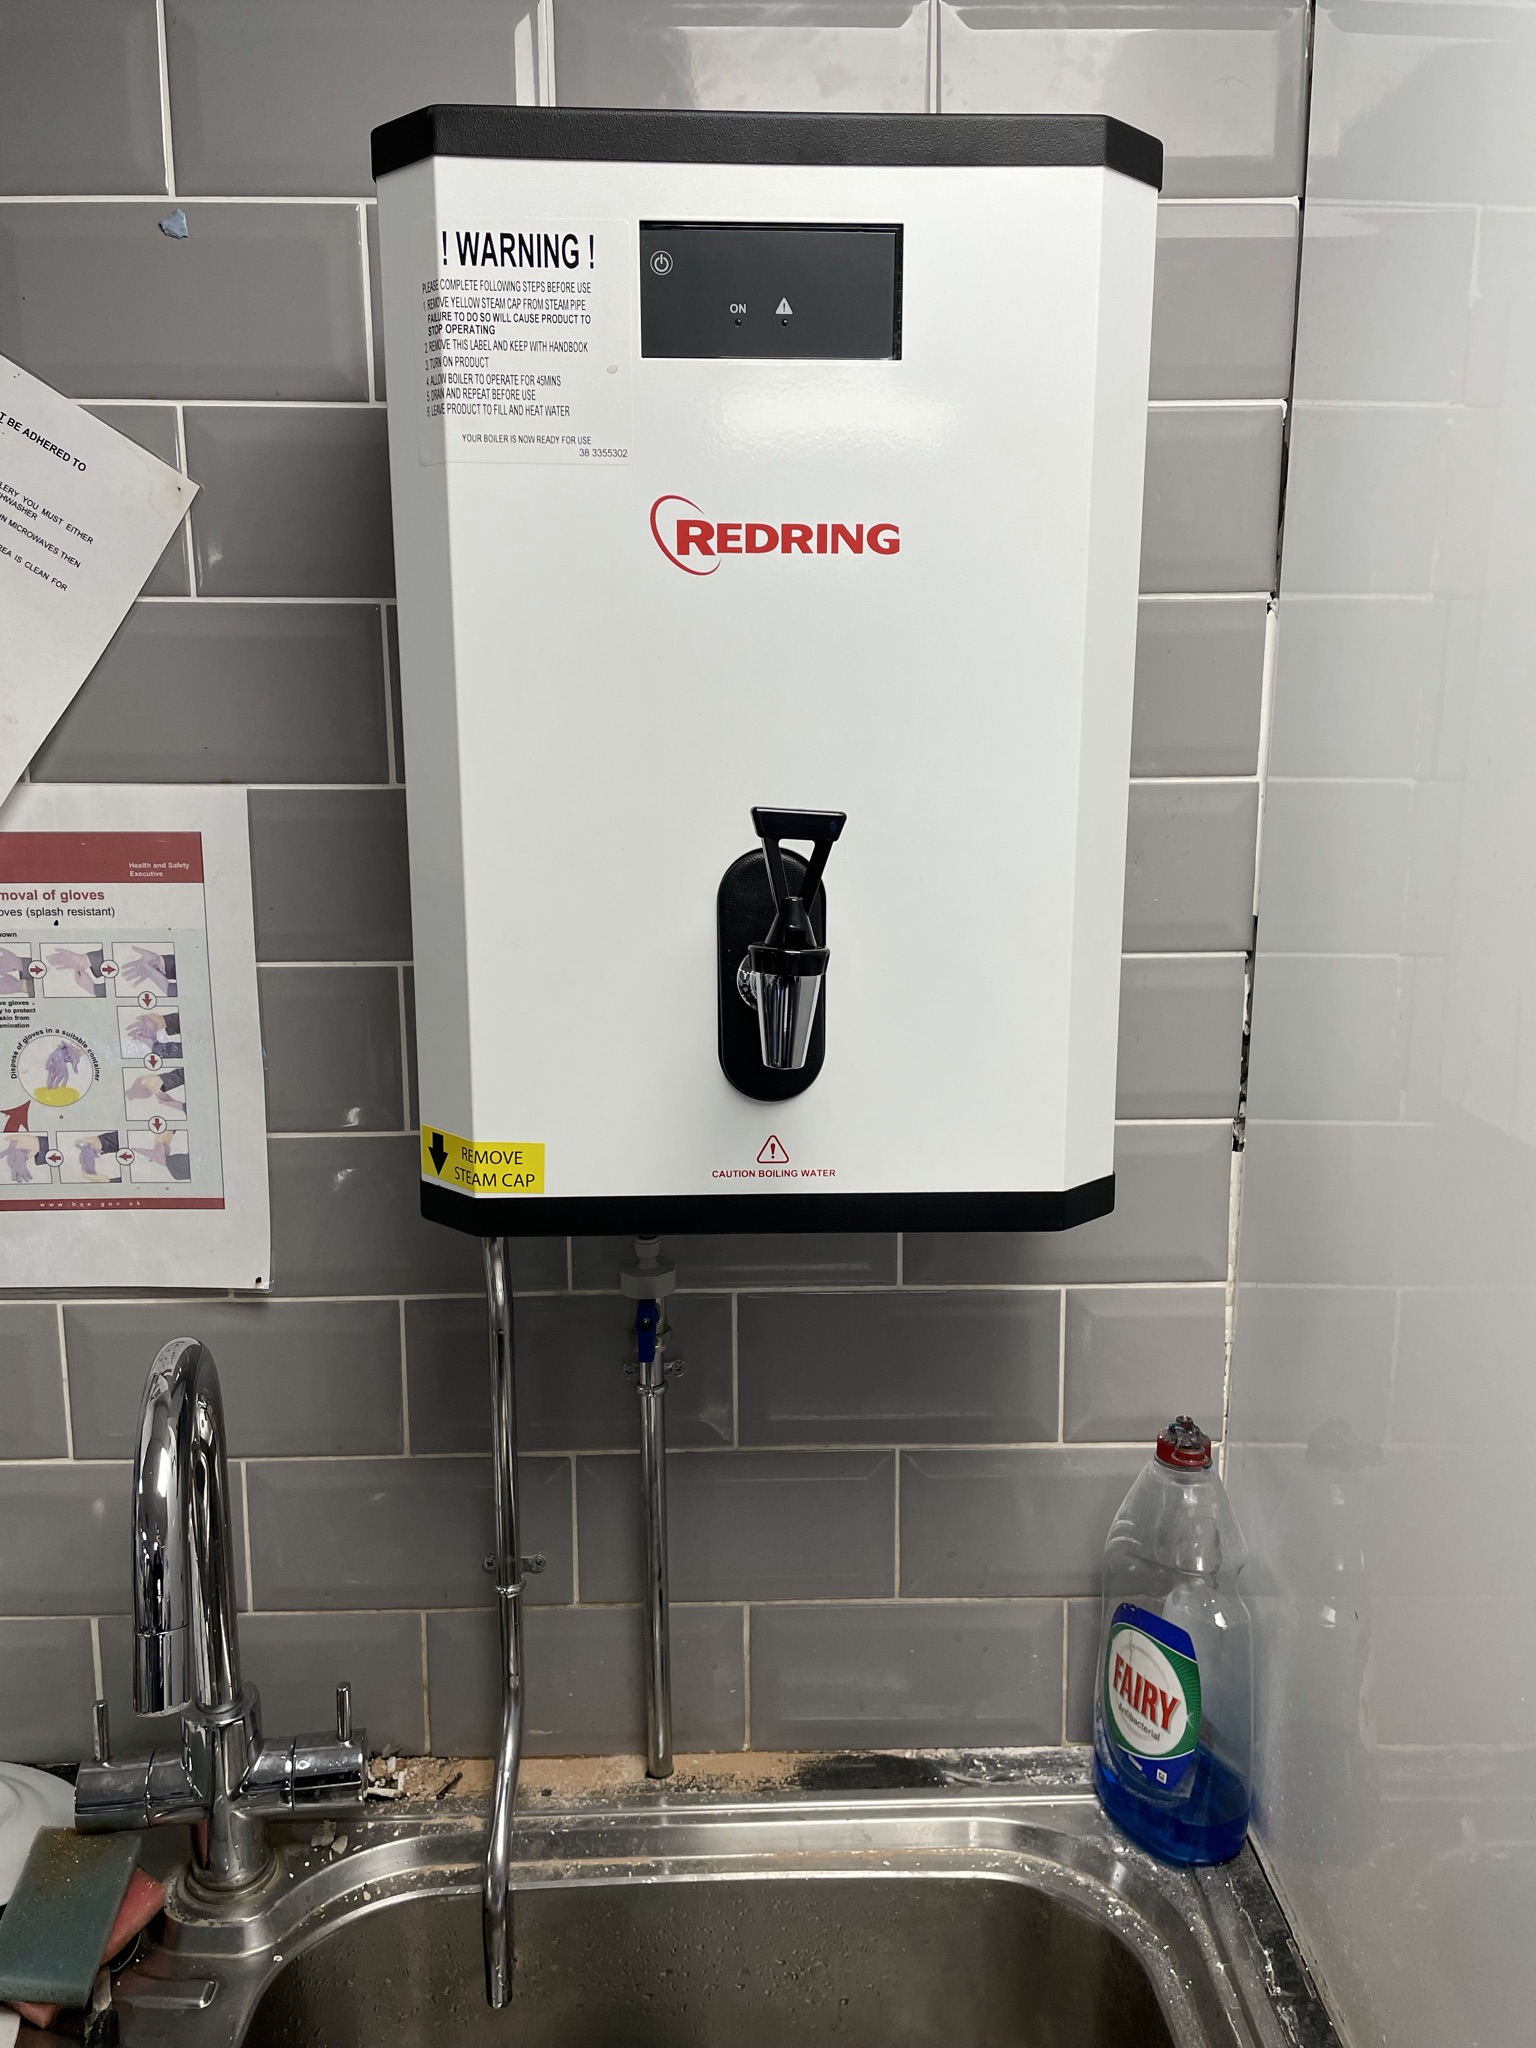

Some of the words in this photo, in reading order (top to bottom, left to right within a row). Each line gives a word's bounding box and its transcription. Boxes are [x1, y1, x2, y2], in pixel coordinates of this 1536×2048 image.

[456, 231, 580, 270] WARNING
[422, 279, 438, 294] PLEASE
[440, 279, 478, 291] COMPLETE
[480, 280, 521, 292] FOLLOWING
[522, 281, 545, 293] STEPS
[547, 281, 575, 293] BEFORE
[577, 282, 591, 294] USE
[427, 297, 449, 310] REMOVE
[451, 297, 480, 308] YELLOW
[481, 297, 506, 309] STEAM
[507, 298, 521, 309] CAP
[523, 299, 543, 310] FROM
[545, 299, 569, 310] STEAM
[570, 300, 586, 311] PIPE
[730, 303, 747, 314] ON
[428, 312, 452, 324] FAILURE
[454, 312, 465, 322] TO
[467, 312, 478, 322] DO
[480, 312, 491, 322] SO
[493, 313, 511, 322] WILL
[513, 313, 539, 323] CAUSE
[541, 314, 578, 324] PRODUCT
[580, 315, 591, 324] TO
[428, 324, 442, 336] STOP
[445, 324, 496, 335] OPERATING
[429, 339, 450, 352] REMOVE
[452, 339, 469, 350] THIS
[470, 340, 492, 351] LABEL
[493, 340, 508, 351] AND
[510, 341, 528, 352] KEEP
[530, 341, 547, 352] WITH
[549, 341, 588, 353] HANDBOOK
[430, 356, 442, 369] TURN
[443, 356, 453, 367] ON
[455, 357, 489, 368] PRODUCT
[430, 374, 446, 386] ALLOW
[448, 373, 474, 384] BOILER
[475, 374, 484, 385] TO
[486, 374, 519, 385] OPERATE
[520, 375, 535, 386] FOR
[537, 375, 561, 386] 45MINS
[446, 388, 461, 399] AND
[463, 388, 490, 399] REPEAT
[492, 389, 520, 400] BEFORE
[522, 390, 536, 400] USE
[431, 403, 445, 417] LEAVE
[446, 403, 481, 415] PRODUCT
[483, 404, 492, 415] TO
[494, 404, 507, 415] FILL
[509, 405, 524, 415] AND
[526, 405, 544, 416] HEAT
[545, 405, 570, 417] WATER
[7, 417, 22, 432] BE
[22, 428, 71, 462] ADHERED
[73, 458, 87, 472] TO
[462, 434, 482, 442] YOUR
[484, 435, 508, 443] BOILER
[510, 435, 517, 443] IS
[519, 435, 535, 443] NOW
[536, 436, 560, 444] READY
[561, 436, 576, 444] FOR
[578, 436, 591, 444] USE
[579, 449, 589, 457] 38
[592, 449, 628, 458] 3355302
[0, 492, 38, 520] HWASHER
[0, 481, 20, 497] LERY
[22, 496, 39, 510] YOU
[41, 508, 64, 525] MUST
[65, 524, 94, 544] EITHER
[8, 519, 59, 555] MICROWAVES
[60, 551, 81, 568] THEN
[676, 519, 900, 556] REDRING
[14, 554, 23, 563] IS
[24, 561, 50, 580] CLEAN
[51, 577, 68, 591] FOR
[43, 890, 56, 900] of
[60, 890, 105, 903] gloves
[26, 907, 64, 918] (splash
[67, 907, 115, 918] resistant)
[23, 1030, 44, 1044] gloves
[62, 1030, 88, 1049] suitable
[87, 1049, 100, 1082] container
[462, 1147, 523, 1165] REMOVE
[455, 1167, 497, 1187] STEAM
[502, 1173, 535, 1187] CAP
[712, 1170, 756, 1178] CAUTION
[758, 1169, 798, 1178] BOILING
[800, 1169, 836, 1177] WATER
[1113, 1652, 1180, 1733] FAIRY
[1118, 1703, 1160, 1741] Antibacterial
